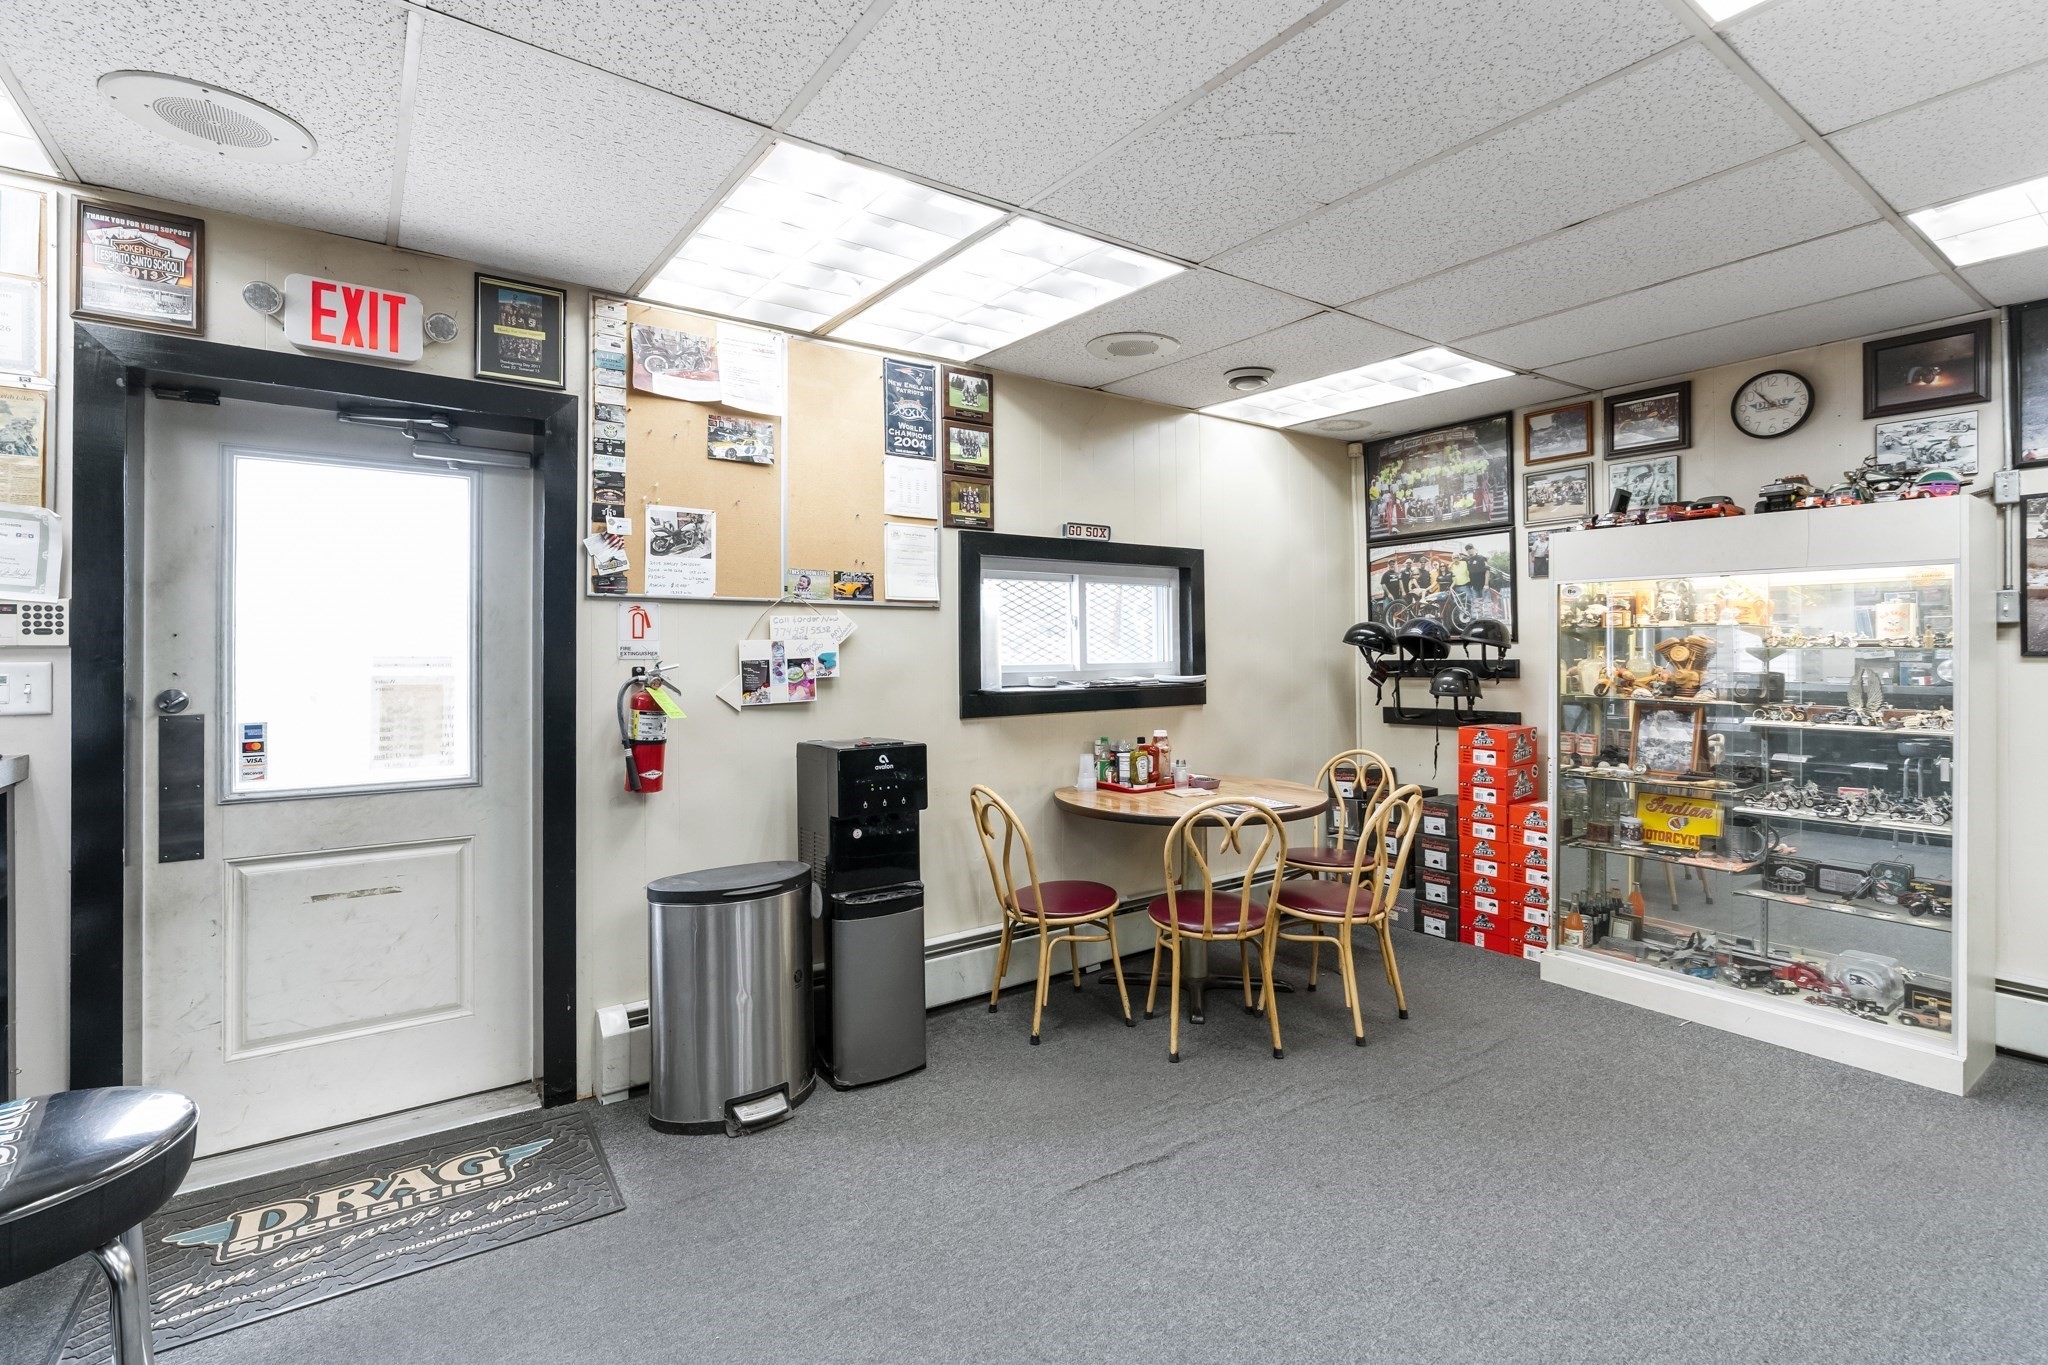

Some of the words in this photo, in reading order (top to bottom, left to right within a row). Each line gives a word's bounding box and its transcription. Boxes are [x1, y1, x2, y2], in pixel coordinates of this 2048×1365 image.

[86, 212, 110, 222] THANK
[111, 216, 125, 225] YOU
[126, 220, 140, 228] FOR
[140, 222, 159, 232] YOUR
[160, 226, 191, 238] SUPPORT
[119, 244, 145, 255] POKER
[146, 248, 162, 258] RUN
[100, 250, 130, 264] ESPIRITO
[130, 254, 153, 268] SANTO
[153, 259, 179, 273] SCHOOL
[122, 266, 158, 280] 2013
[311, 280, 406, 353] EXIT
[888, 379, 902, 388] NEW
[904, 382, 933, 392] ENGLAND
[1765, 376, 1778, 387] 12
[1784, 376, 1790, 387] 1
[1794, 382, 1802, 393] 2
[896, 386, 924, 396] PATRIOTS
[1743, 391, 1755, 402] 10
[1799, 394, 1807, 405] 3
[889, 402, 931, 421] XXXIX
[1740, 405, 1747, 415] 9
[1794, 408, 1802, 416] 4
[898, 422, 924, 432] WORLD
[1744, 416, 1751, 426] 8
[1755, 422, 1761, 432] 7
[1782, 418, 1790, 429] 5
[888, 428, 932, 440] CHAMPIONS
[1768, 423, 1776, 433] 6
[893, 437, 927, 449] 2004
[1069, 526, 1081, 536] GO
[1086, 527, 1107, 538] SOX
[1646, 796, 1713, 819] Indian
[1642, 829, 1700, 846] OTORCYCL
[229, 1150, 508, 1242] DRAG
[227, 1172, 509, 1257] Specialties
[375, 1200, 570, 1260] PYTHONPERFORMANCE.COM
[156, 1268, 259, 1310] From
[272, 1245, 327, 1268] our
[341, 1206, 442, 1249] garage
[487, 1182, 556, 1212] yours
[151, 1270, 327, 1328] AGSPECIALTIES.COM
